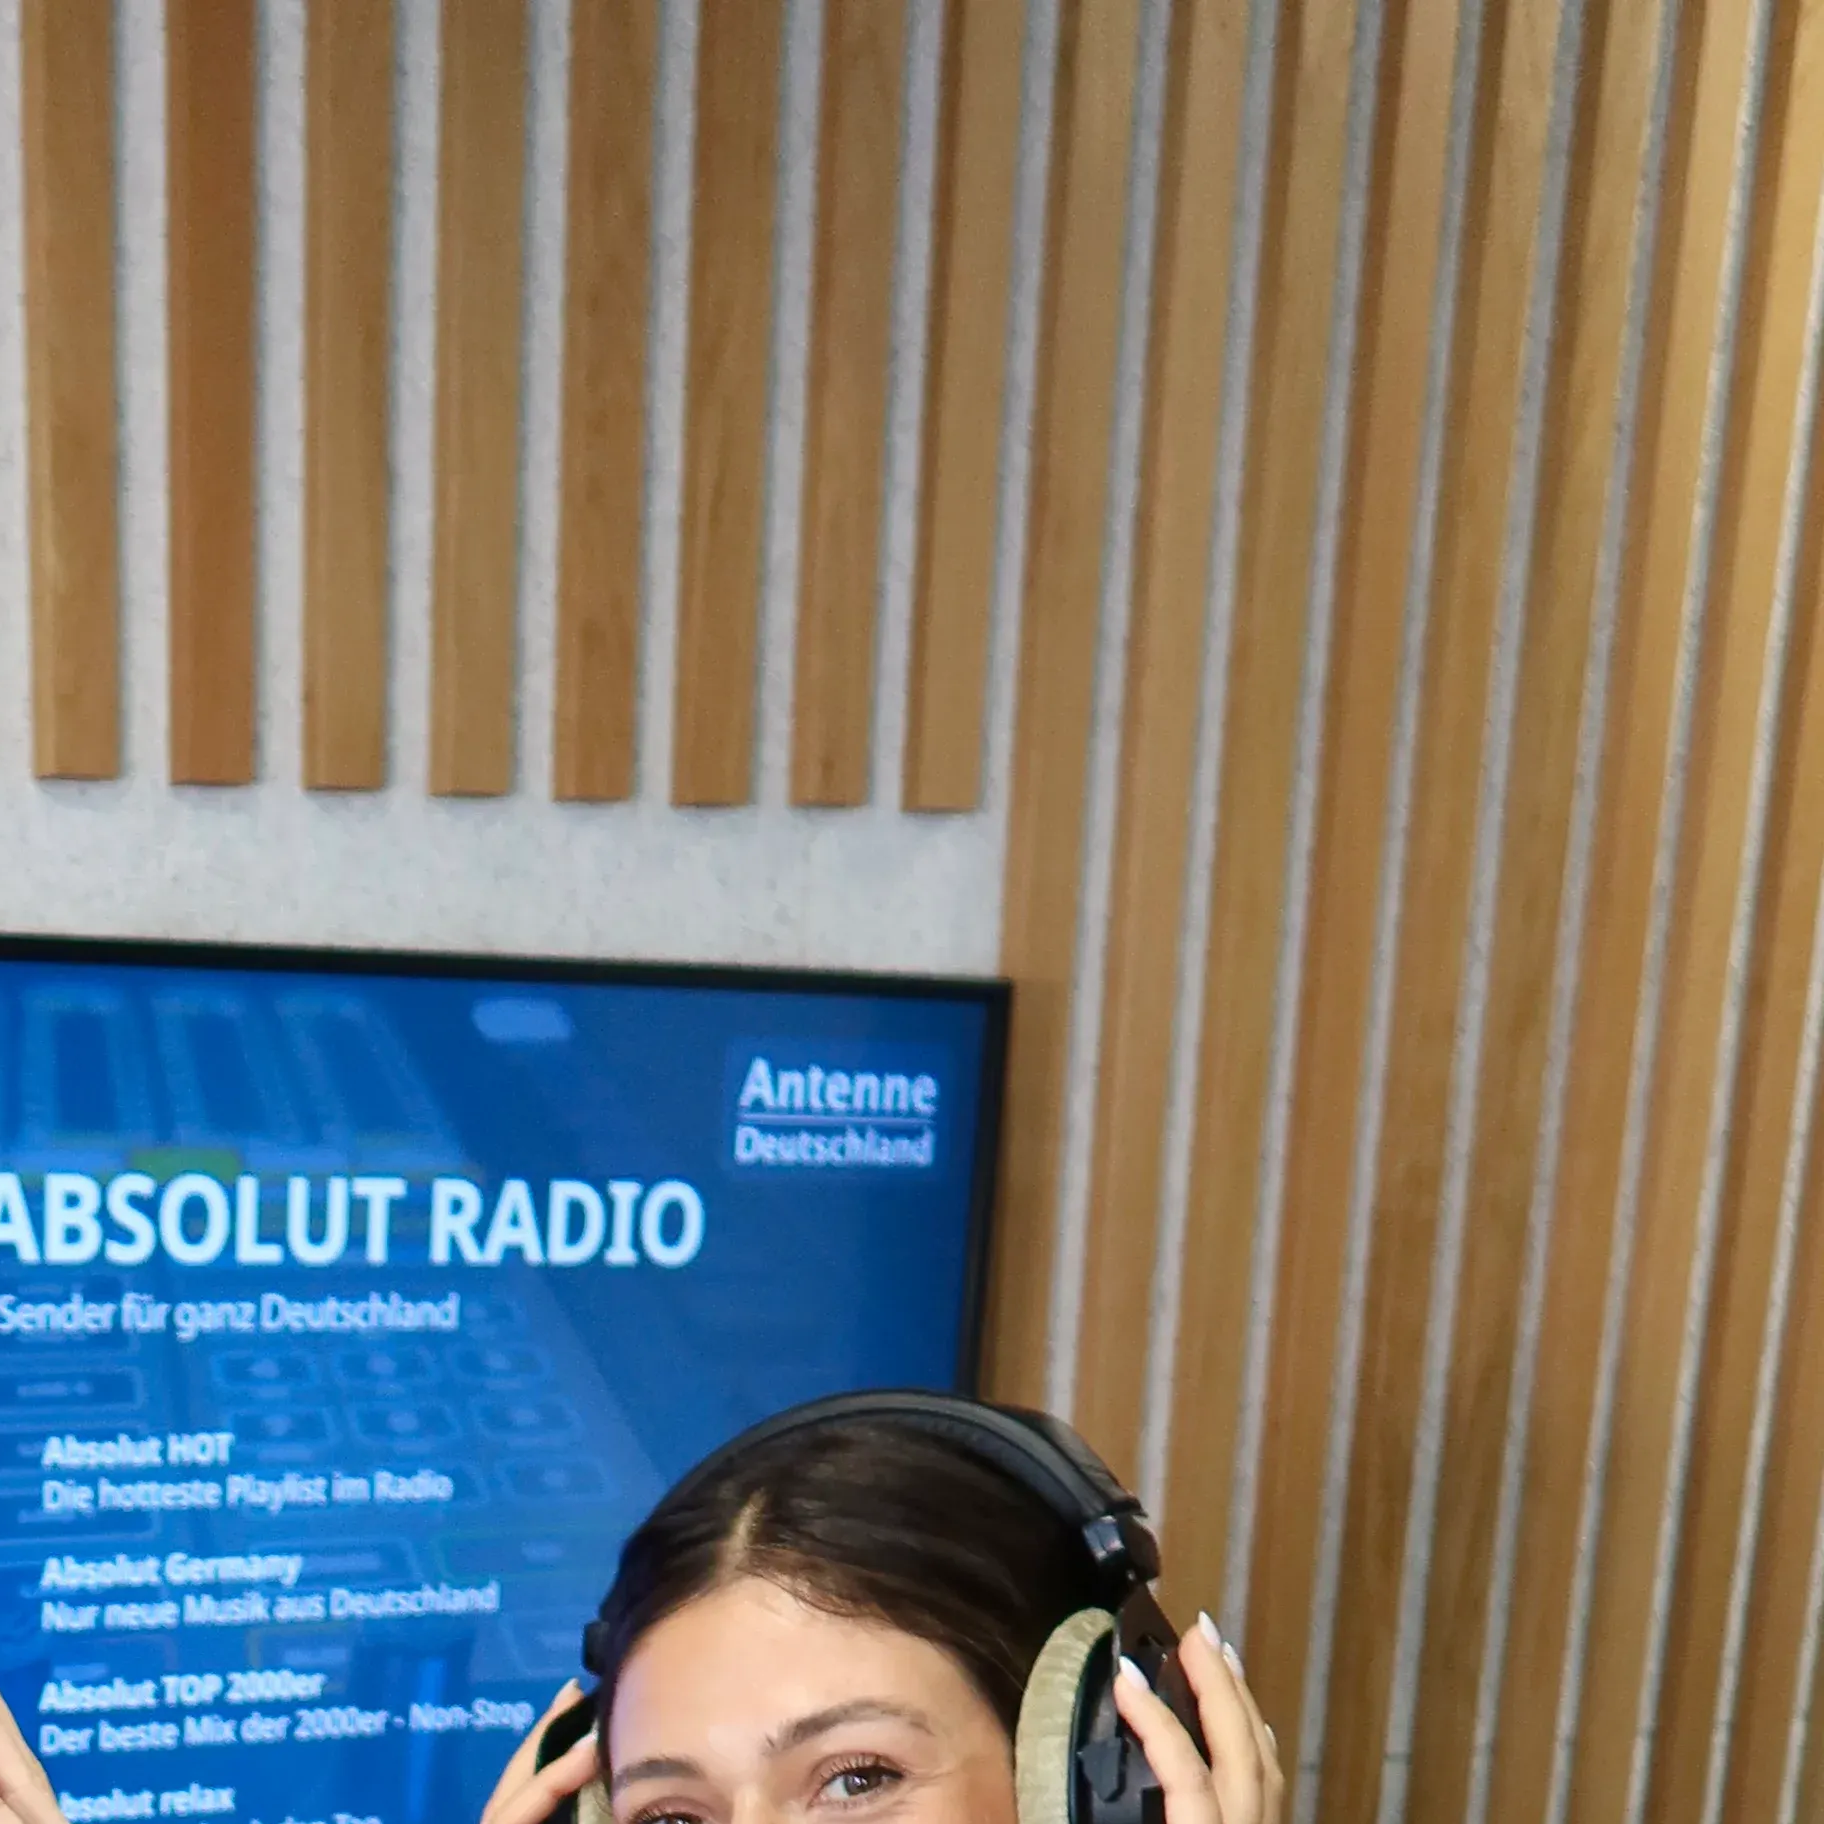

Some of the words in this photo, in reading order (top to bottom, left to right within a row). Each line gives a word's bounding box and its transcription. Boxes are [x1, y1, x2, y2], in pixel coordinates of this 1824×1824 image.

[739, 1056, 940, 1116] Antenne
[734, 1123, 935, 1167] Deutschland
[428, 1177, 706, 1269] RADIO
[121, 1291, 172, 1333] für
[174, 1301, 256, 1343] ganz
[258, 1291, 462, 1333] Deutschland
[41, 1433, 163, 1469] Absolut
[166, 1432, 237, 1468] HOT
[42, 1478, 96, 1516] Die
[97, 1475, 223, 1512] hotteste
[226, 1472, 328, 1515] Playlist
[331, 1470, 371, 1502] im
[373, 1467, 455, 1503] Radio
[40, 1553, 162, 1591] Absolut
[163, 1551, 303, 1590] Germany
[41, 1601, 101, 1633] Nur
[103, 1600, 180, 1631] neue
[182, 1590, 271, 1627] Musik
[272, 1593, 327, 1623] aus
[328, 1578, 501, 1620] Deutschland
[38, 1676, 158, 1715] Absolut
[159, 1672, 224, 1707] TOP
[225, 1668, 328, 1704] 2000er
[39, 1723, 94, 1757] Der
[97, 1718, 180, 1752] beste
[182, 1712, 238, 1746] Mix
[239, 1710, 292, 1744] der
[293, 1705, 390, 1743] 2000er
[407, 1696, 536, 1737] Non-Stop
[59, 1787, 156, 1824] bsolut
[158, 1781, 237, 1819] relax
